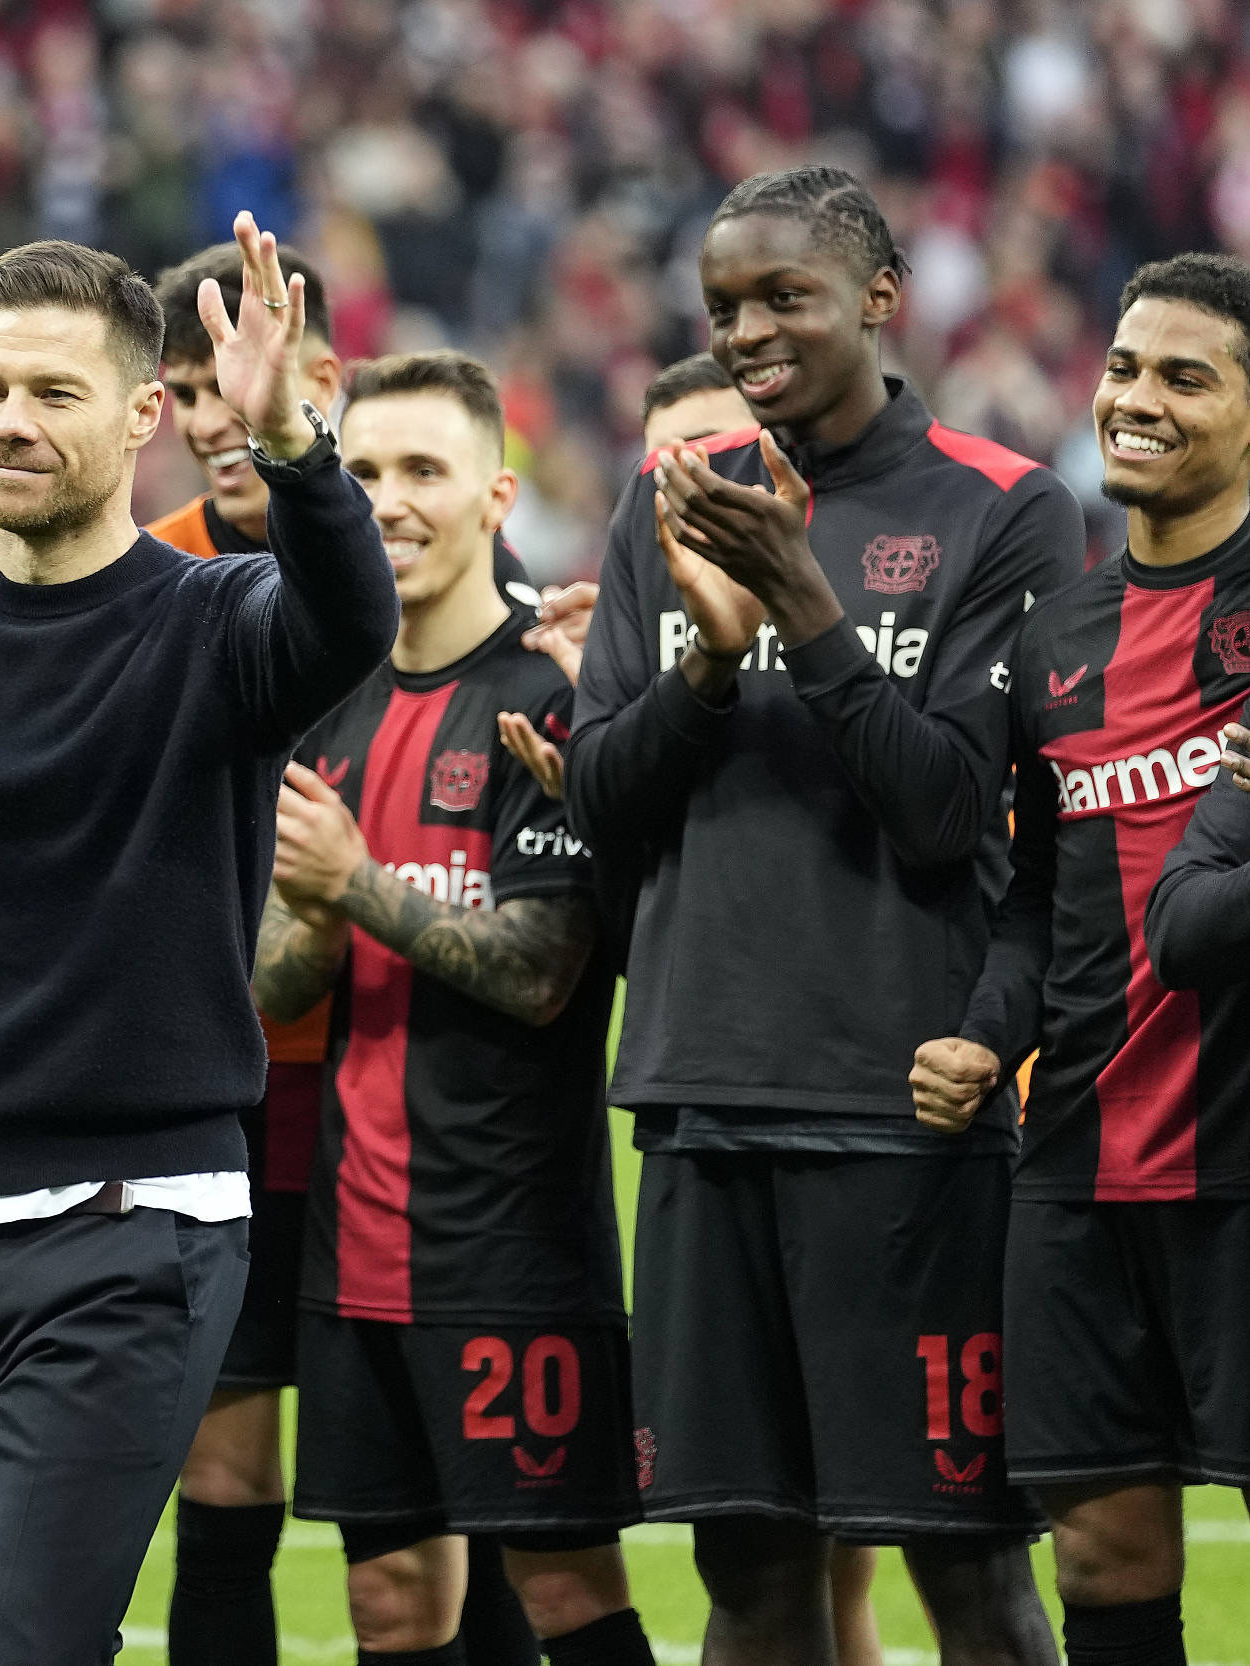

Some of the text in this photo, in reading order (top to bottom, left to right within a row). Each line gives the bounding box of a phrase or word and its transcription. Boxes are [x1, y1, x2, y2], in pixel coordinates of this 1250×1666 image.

[516, 826, 593, 858] triv
[460, 1335, 582, 1440] 20
[915, 1331, 1004, 1440] 18
